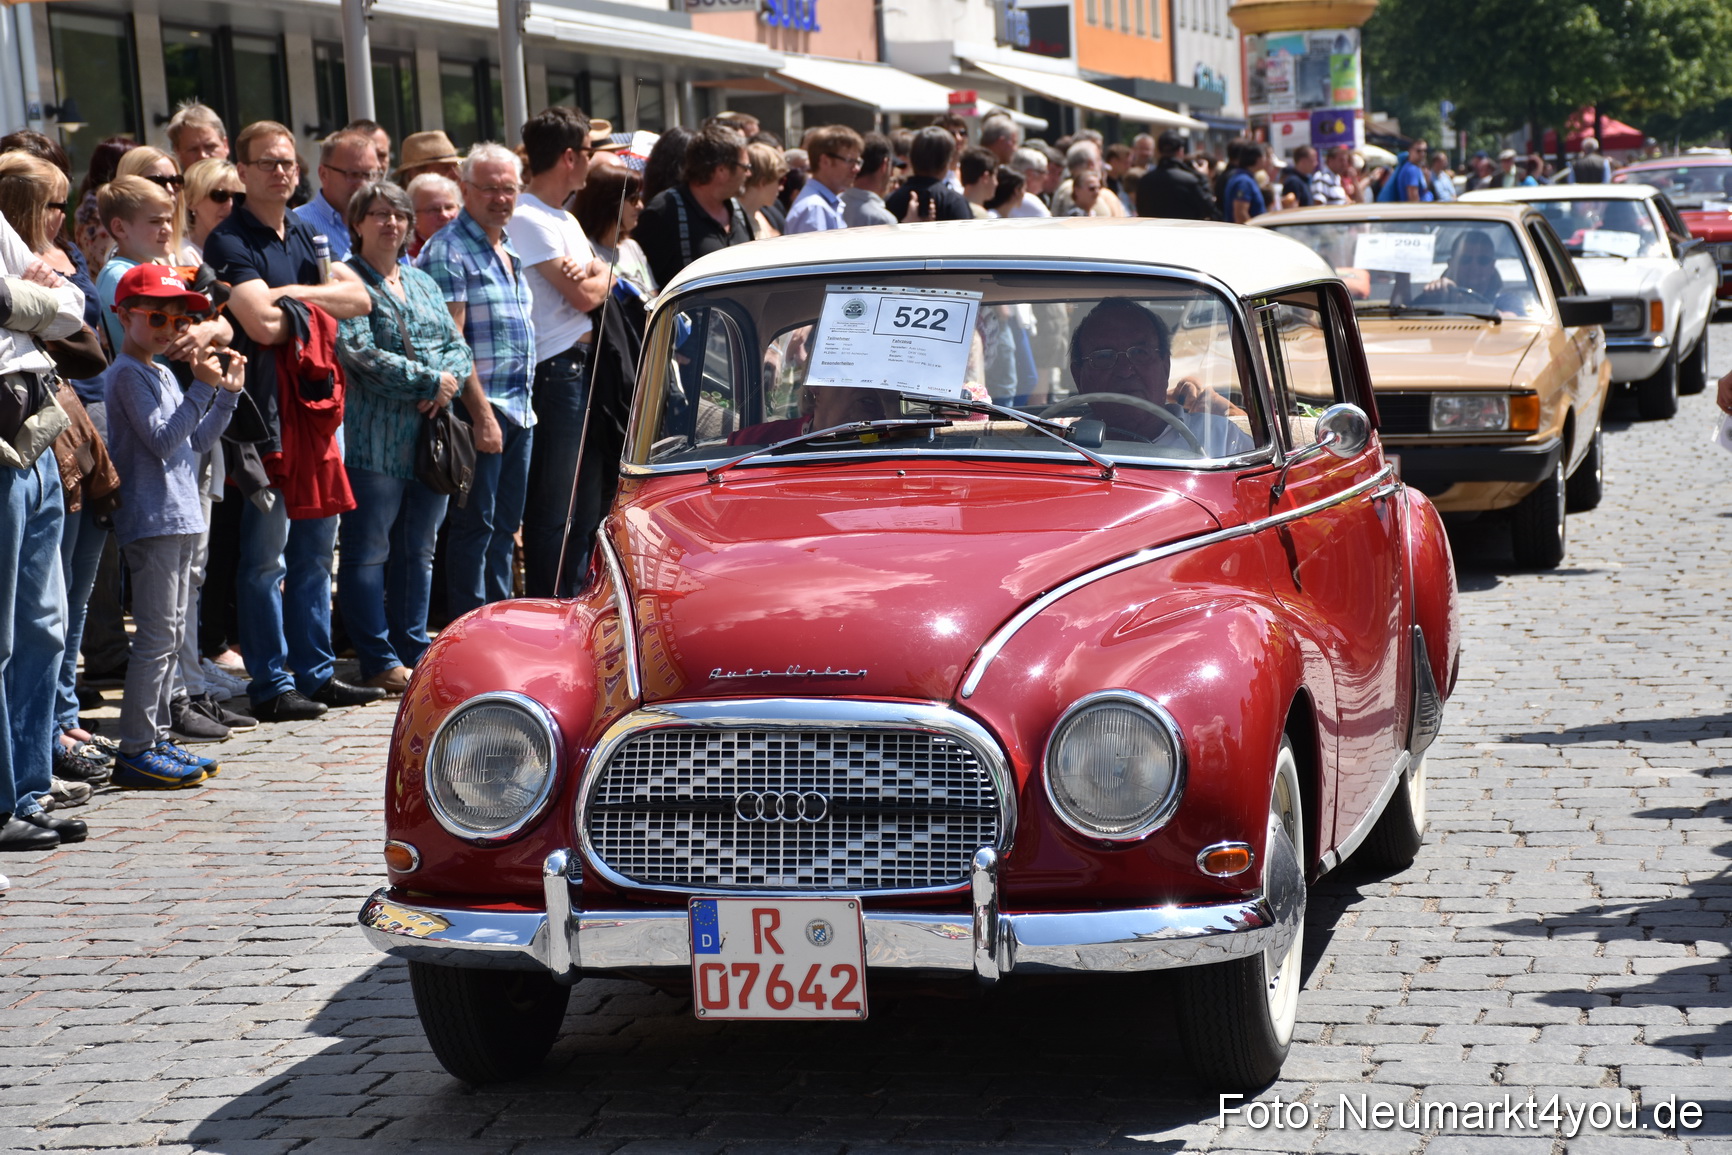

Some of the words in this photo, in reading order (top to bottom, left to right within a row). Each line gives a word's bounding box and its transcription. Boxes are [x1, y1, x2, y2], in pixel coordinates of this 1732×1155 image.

[893, 306, 949, 332] 522
[709, 668, 771, 680] Auto
[785, 664, 868, 681] Union
[701, 934, 713, 948] D
[752, 908, 785, 954] R
[699, 962, 861, 1011] 07642
